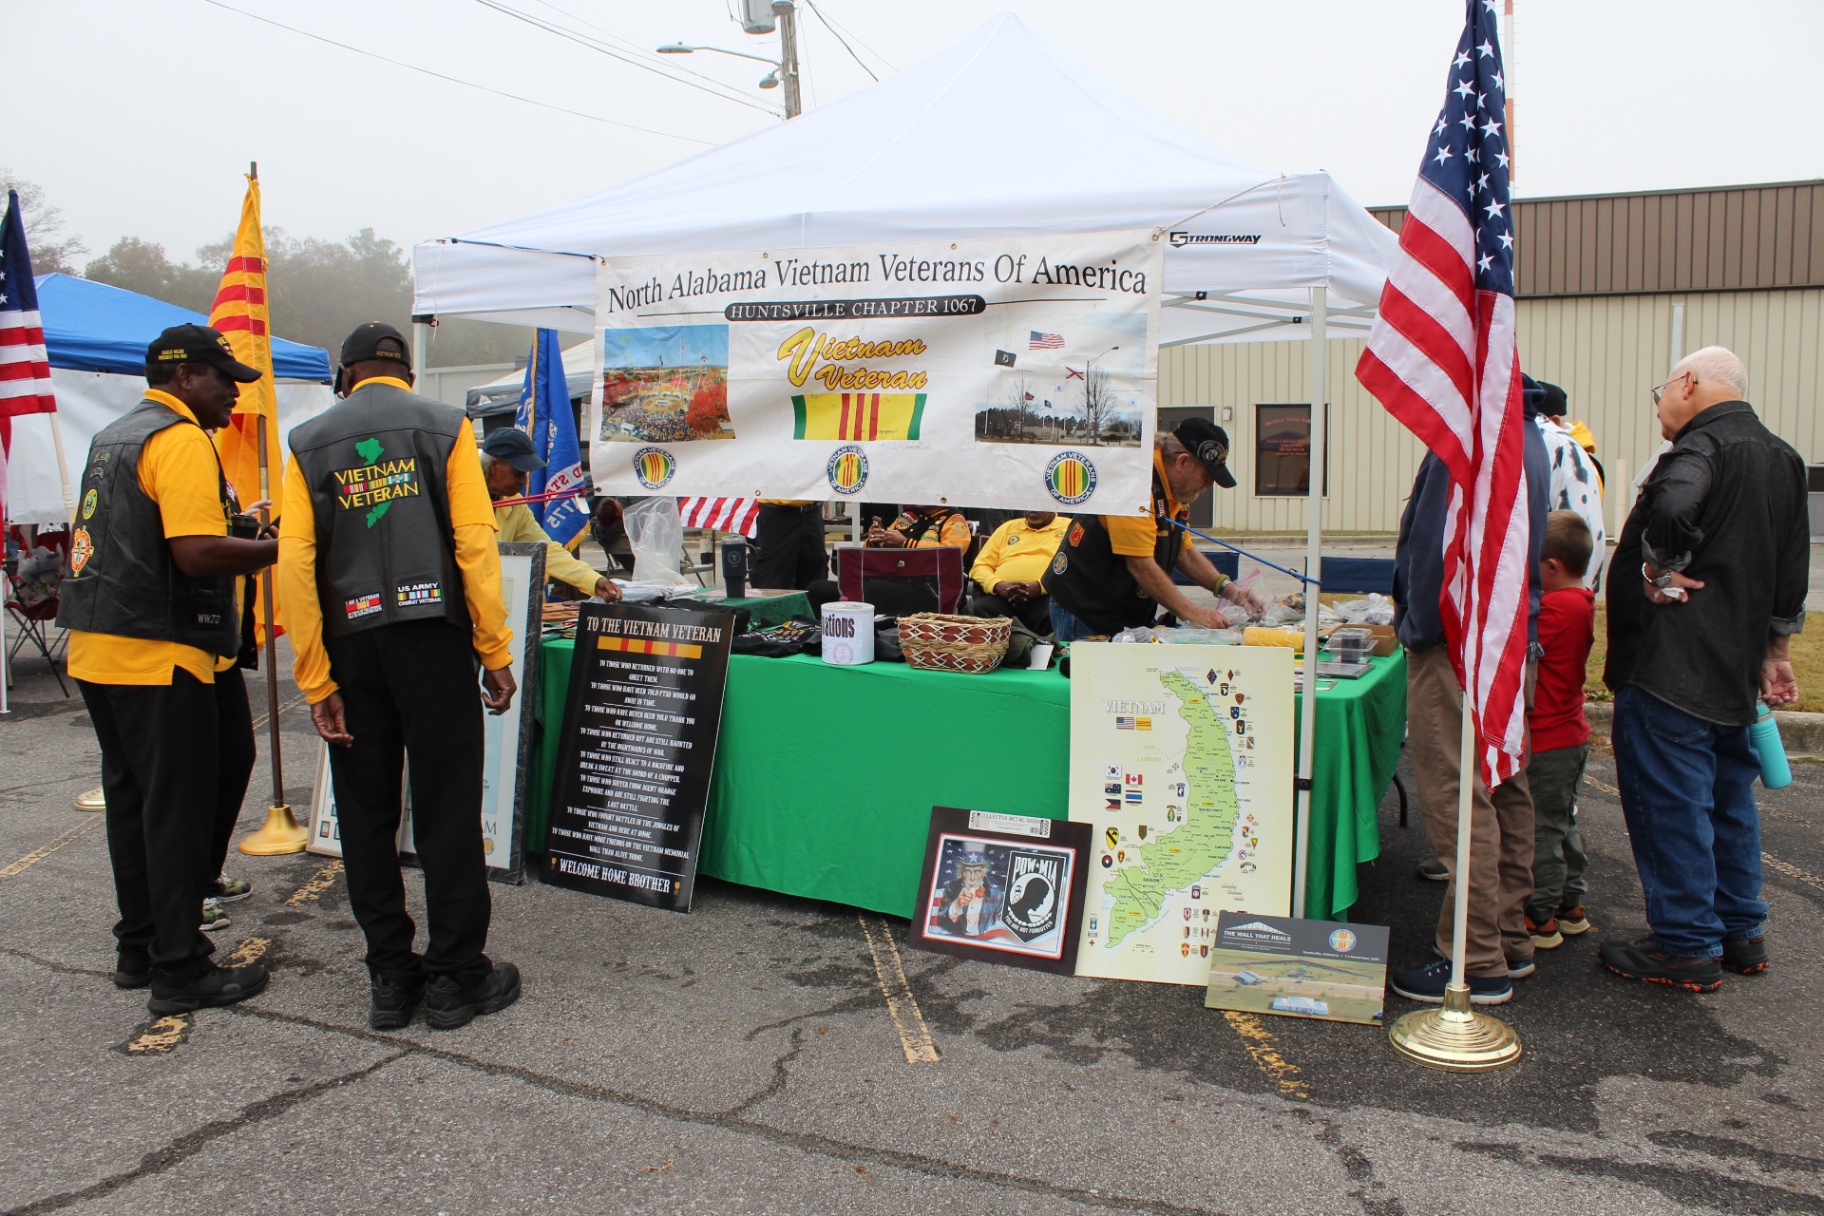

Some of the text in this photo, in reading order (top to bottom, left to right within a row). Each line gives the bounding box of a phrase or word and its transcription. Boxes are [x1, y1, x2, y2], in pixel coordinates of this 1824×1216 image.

[1169, 232, 1262, 248] STRONGWAY
[608, 253, 1147, 313] North Alabama Vietnam Veterans Of America
[731, 297, 977, 318] HUNTSVILLE CHAPTER 1067
[777, 326, 927, 387] Vietnam
[815, 363, 928, 391] Veteran
[828, 447, 847, 473] VIETNAM
[1046, 452, 1096, 482] VIETNAM VETERANS
[334, 458, 415, 485] VIETNAM
[338, 481, 419, 510] VETERAN
[1050, 488, 1059, 497] OF
[412, 582, 439, 591] ARMY
[359, 593, 380, 603] VETERAN
[197, 613, 221, 624] WWJD
[586, 616, 599, 632] TO
[601, 617, 622, 634] THE
[623, 619, 671, 638] VIETNAM
[672, 624, 721, 643] VETERAN
[629, 673, 658, 683] GREET THEM.
[632, 663, 655, 671] RETURNED
[656, 665, 669, 673] WITH
[612, 684, 622, 692] WHO
[647, 688, 658, 696] TOLD
[672, 691, 689, 699] WOULD
[591, 705, 695, 725] THOSE WHO HAVE NEVER BEEN TOLD THANK YOU
[1103, 699, 1165, 715] VIETNAM
[622, 720, 657, 730] WELCOME HOME.
[587, 728, 600, 736] THOSE
[601, 730, 611, 738] WHO
[612, 732, 635, 741] RETURNED
[645, 736, 655, 744] ARE
[655, 738, 669, 746] STILL
[670, 740, 693, 749] HAUNTED
[607, 742, 664, 756] THE NIGHTMARES WAR.
[587, 752, 600, 760] THOSE
[612, 755, 624, 763] STILL
[625, 757, 640, 765] REACT
[652, 761, 674, 770] BACKFIRE
[675, 764, 685, 772] AND
[580, 762, 680, 783] BREAK SWEAT THE SOUND CHOPPER.
[587, 775, 600, 784] THOSE
[612, 779, 628, 788] SUFFER
[629, 782, 641, 790] FROM
[642, 784, 657, 792] AGENT
[658, 786, 677, 795] ORANGE
[582, 786, 603, 795] EXPOSURE
[604, 789, 614, 797] AND
[623, 792, 636, 801] STILL
[637, 794, 659, 804] FIGHTING
[660, 798, 670, 806] THE
[607, 801, 638, 811] LAST BATTLE.
[573, 808, 587, 816] THOSE
[588, 810, 597, 818] WHO
[598, 812, 614, 821] FOUGHT
[615, 815, 636, 824] BATTLES
[642, 819, 652, 827] THE
[653, 821, 673, 831] JUNGLES
[588, 821, 608, 831] VIETNAM
[609, 825, 618, 833] AND
[619, 827, 630, 835] HERE
[638, 830, 652, 839] HOME.
[558, 828, 572, 837] THOSE
[572, 831, 581, 839] WHO
[582, 833, 593, 841] HAVE
[594, 835, 606, 843] MORE
[607, 837, 625, 847] FRIENDS
[633, 842, 642, 850] THE
[642, 844, 663, 854] VIETNAM
[664, 848, 690, 859] MEMORIAL
[589, 845, 643, 862] WALL THAN ALIVE TODAY.
[560, 859, 670, 893] WELCOME HOME BROTHER
[1029, 920, 1053, 934] FORGOTTEN
